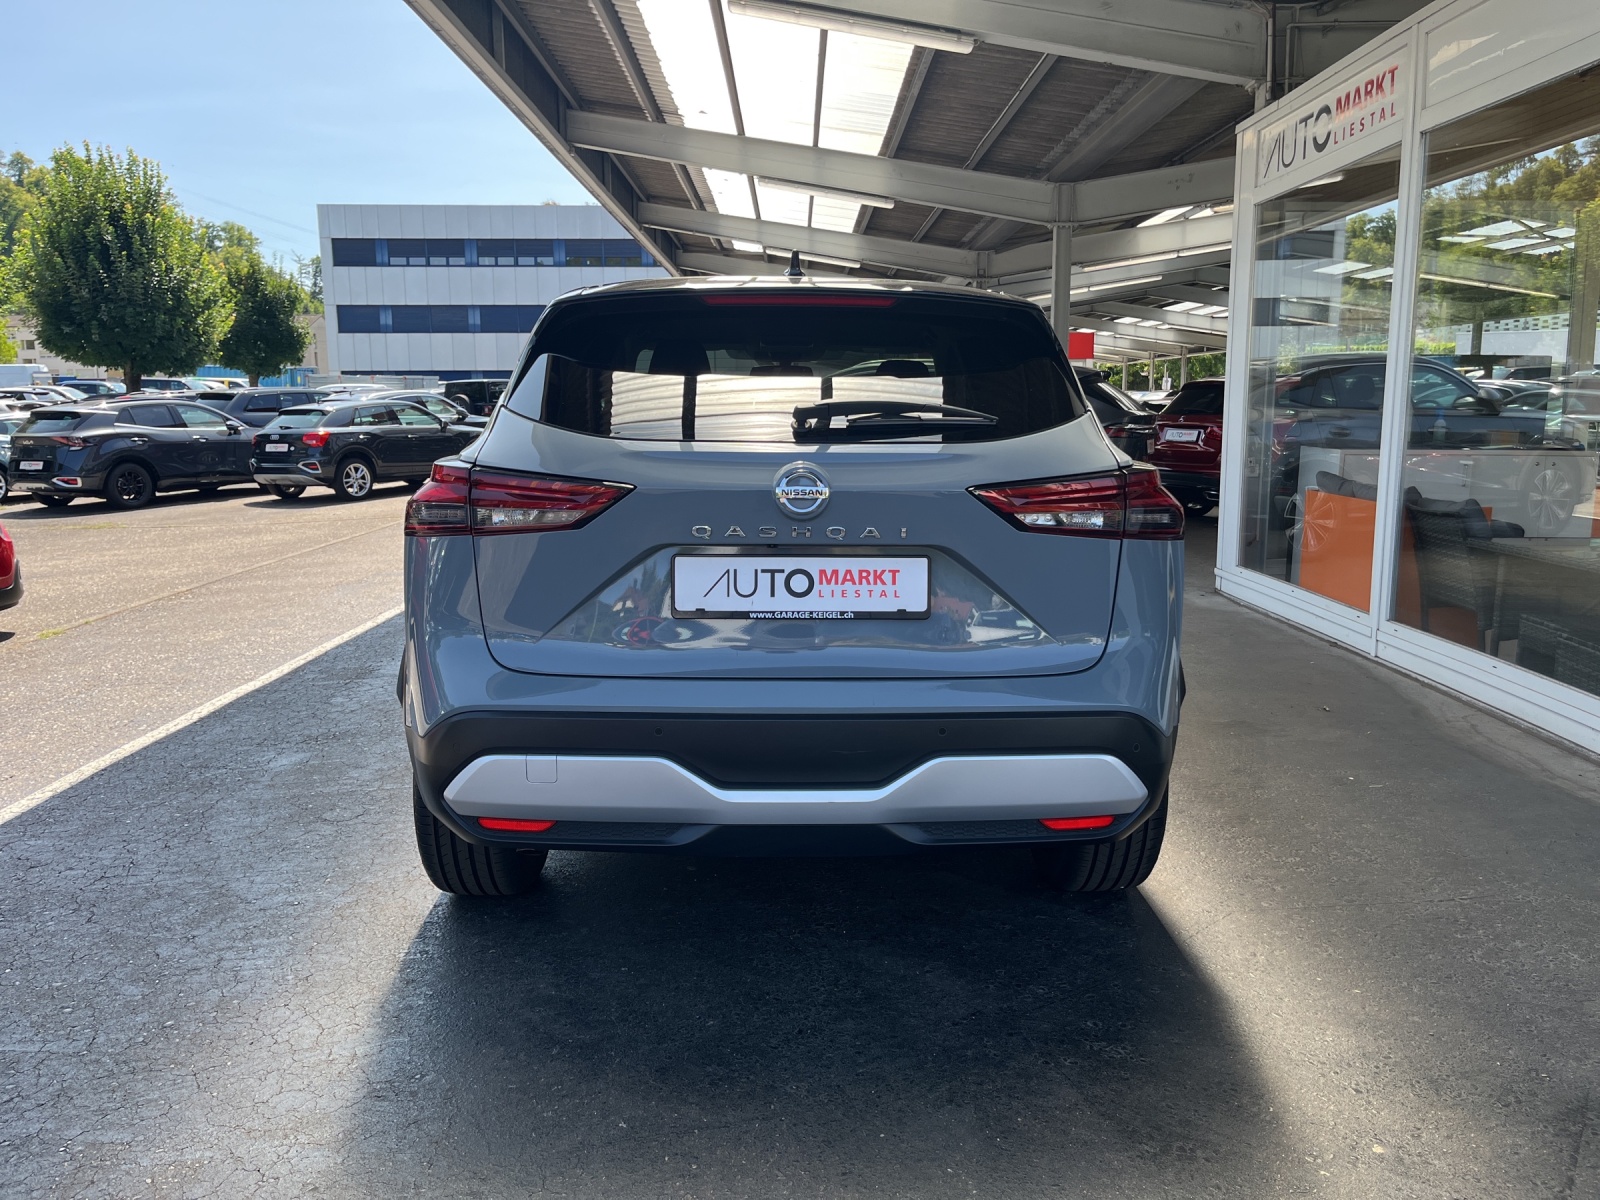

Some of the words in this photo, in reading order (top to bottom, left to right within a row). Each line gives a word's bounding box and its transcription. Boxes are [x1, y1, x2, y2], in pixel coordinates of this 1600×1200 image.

[1264, 103, 1332, 179] AUTO
[1335, 64, 1399, 123] MARKT
[1333, 102, 1396, 145] LIESTAL
[781, 488, 824, 496] NISSAN
[691, 525, 907, 541] QASHQAI
[703, 568, 815, 599] AUTO
[818, 568, 900, 586] MARKT
[818, 589, 900, 598] LIESTAL
[749, 611, 854, 619] www.GARAGE-KEIGEL.ch
